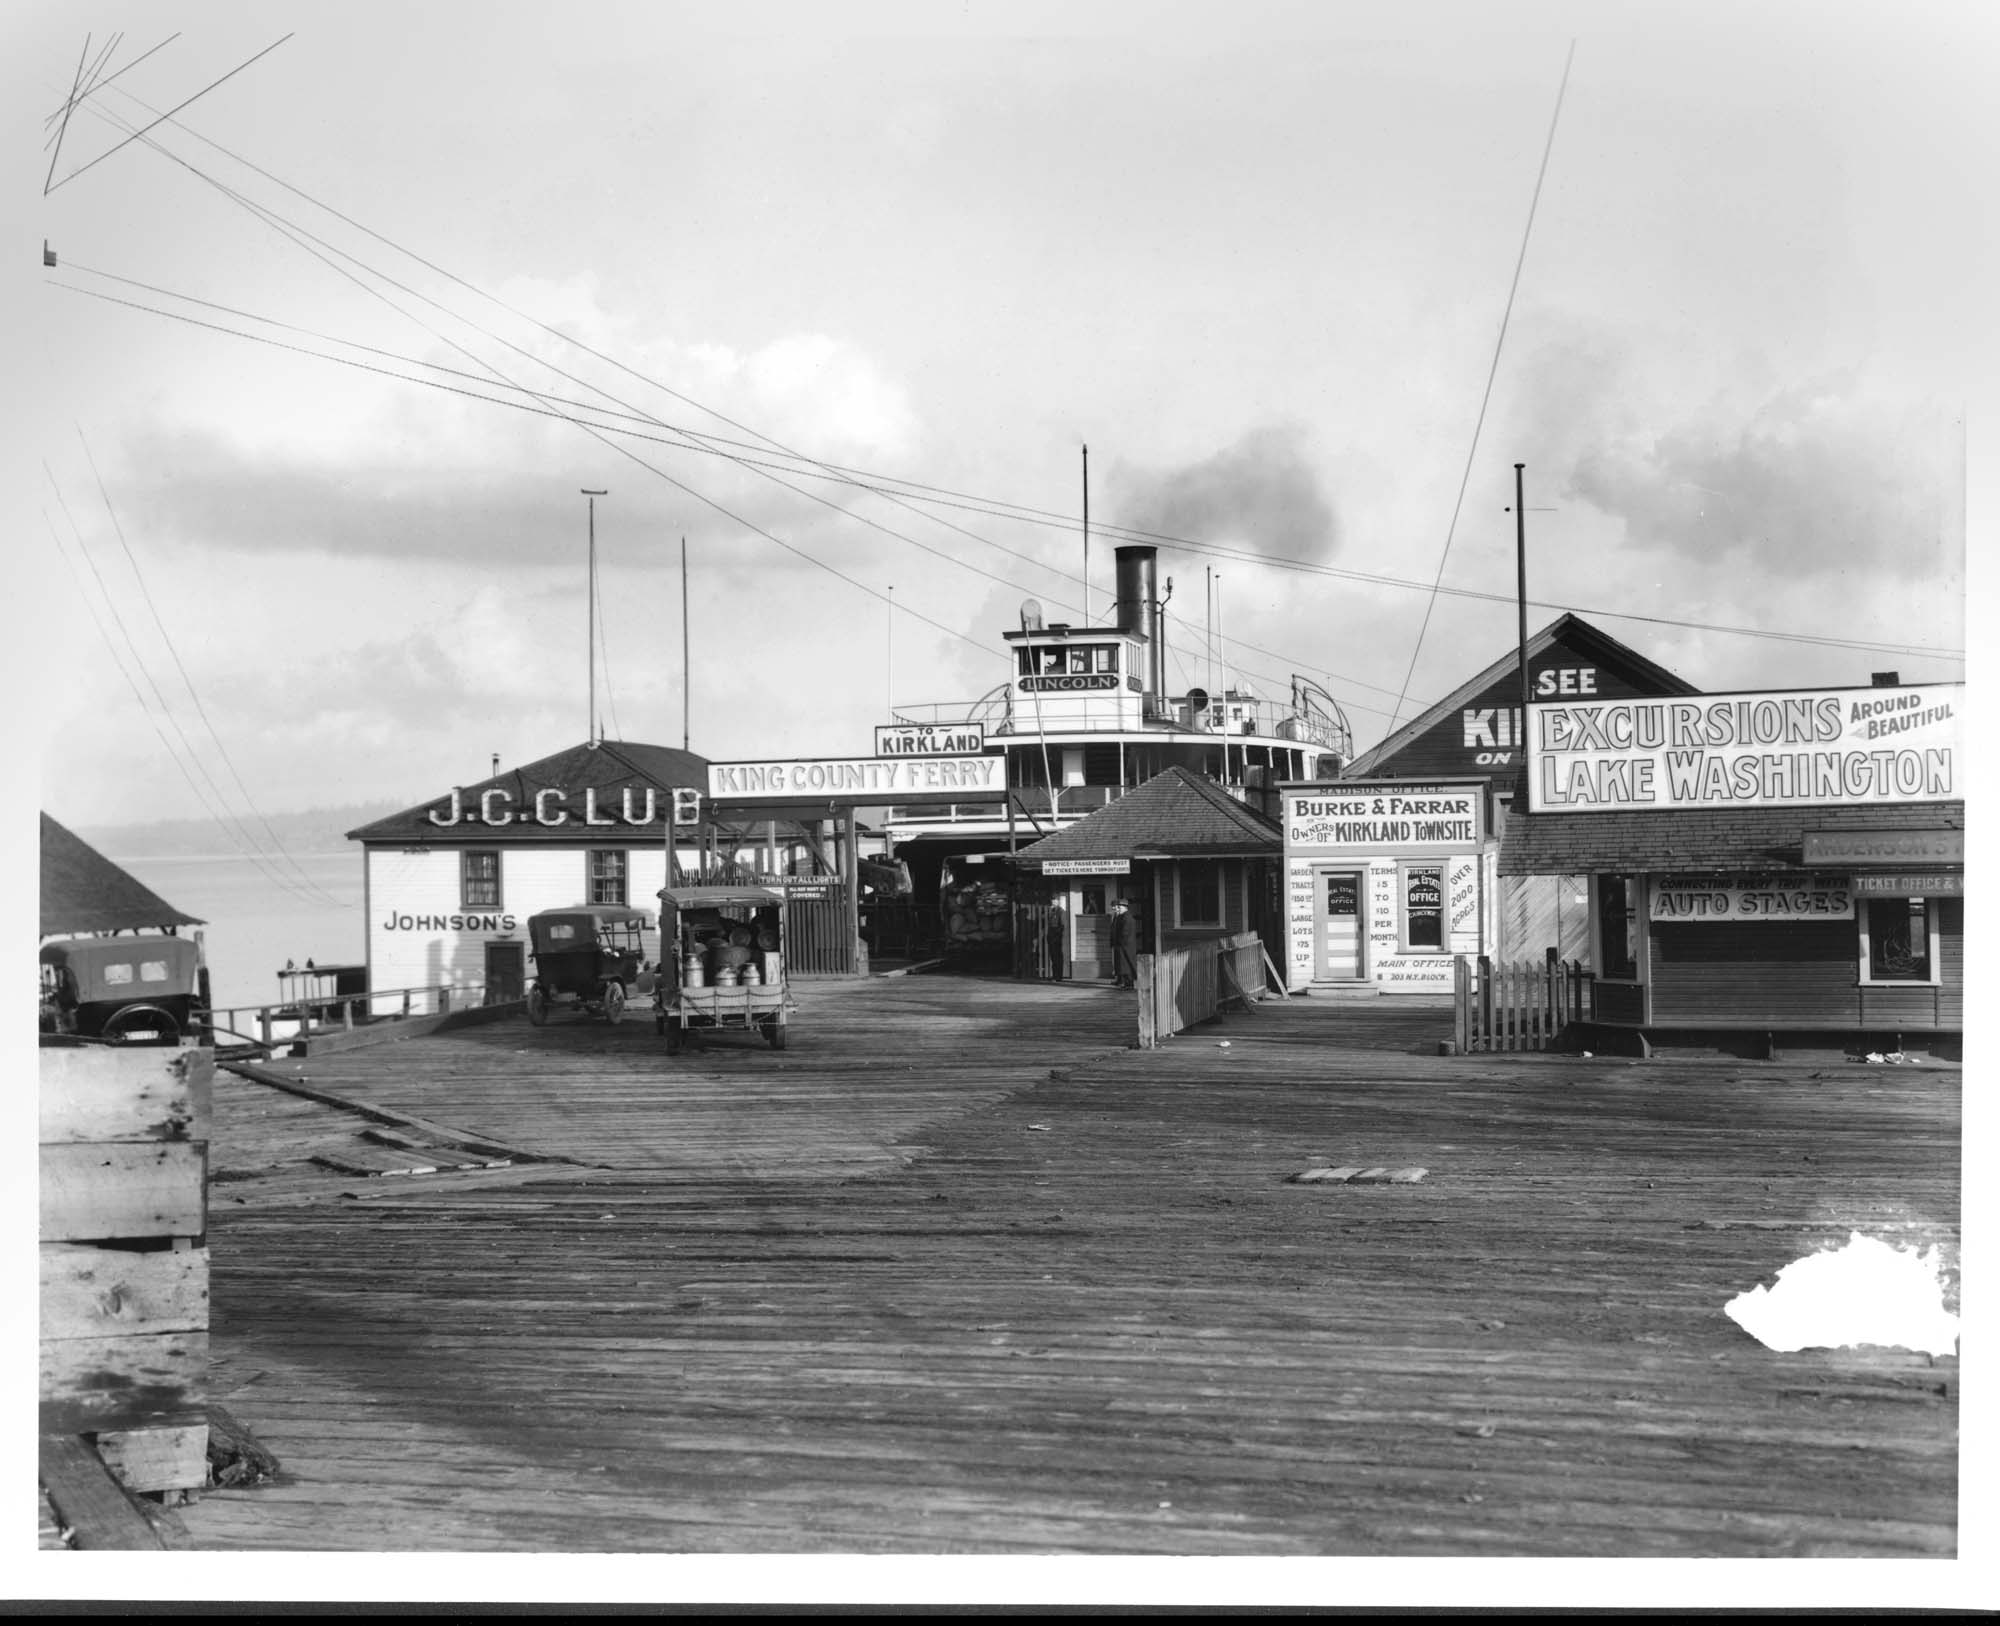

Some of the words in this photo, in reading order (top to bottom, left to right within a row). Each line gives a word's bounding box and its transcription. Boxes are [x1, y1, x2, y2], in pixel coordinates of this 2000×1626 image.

[1025, 676, 1112, 691] LINCOLN
[1537, 668, 1598, 695] SEE
[1851, 694, 1921, 724] AROUND
[1541, 698, 1842, 752] EXCURSIONS
[1868, 704, 1954, 740] BEAUTIFUL
[918, 727, 934, 736] TO
[882, 736, 980, 754] KIRKLAND
[1475, 752, 1512, 765] ON
[717, 765, 786, 793] KING
[790, 761, 899, 789] COUNTY
[905, 759, 995, 787] FERRY
[1542, 755, 1656, 805] LAKE
[1666, 748, 1952, 801] WASHINGTON
[1320, 786, 1382, 796] MADISON
[1296, 800, 1367, 817] BURKE
[1371, 798, 1386, 815] &
[1390, 798, 1470, 815] FARRAR
[1291, 823, 1335, 841] OWNERS
[1316, 832, 1332, 843] OF
[1335, 821, 1411, 843] KIRKLAND
[1290, 868, 1314, 876] GARDEN
[1450, 864, 1473, 885] OVER
[1421, 875, 1441, 890] ESTATE
[1856, 878, 1897, 890] TICKET
[1902, 877, 1941, 890] OFFICE
[1410, 892, 1440, 902] OFFICE
[1451, 884, 1473, 907] 2000
[1653, 892, 1729, 916] AUTO
[1738, 891, 1849, 915] STAGES
[383, 910, 517, 931] JOHNSON'S
[1291, 914, 1312, 922] LARGE
[1451, 901, 1475, 928] ACRES
[1292, 927, 1313, 935] LOTS
[1374, 920, 1392, 928] PER
[1376, 960, 1407, 968] MAIN
[1412, 959, 1455, 968] OFFICE
